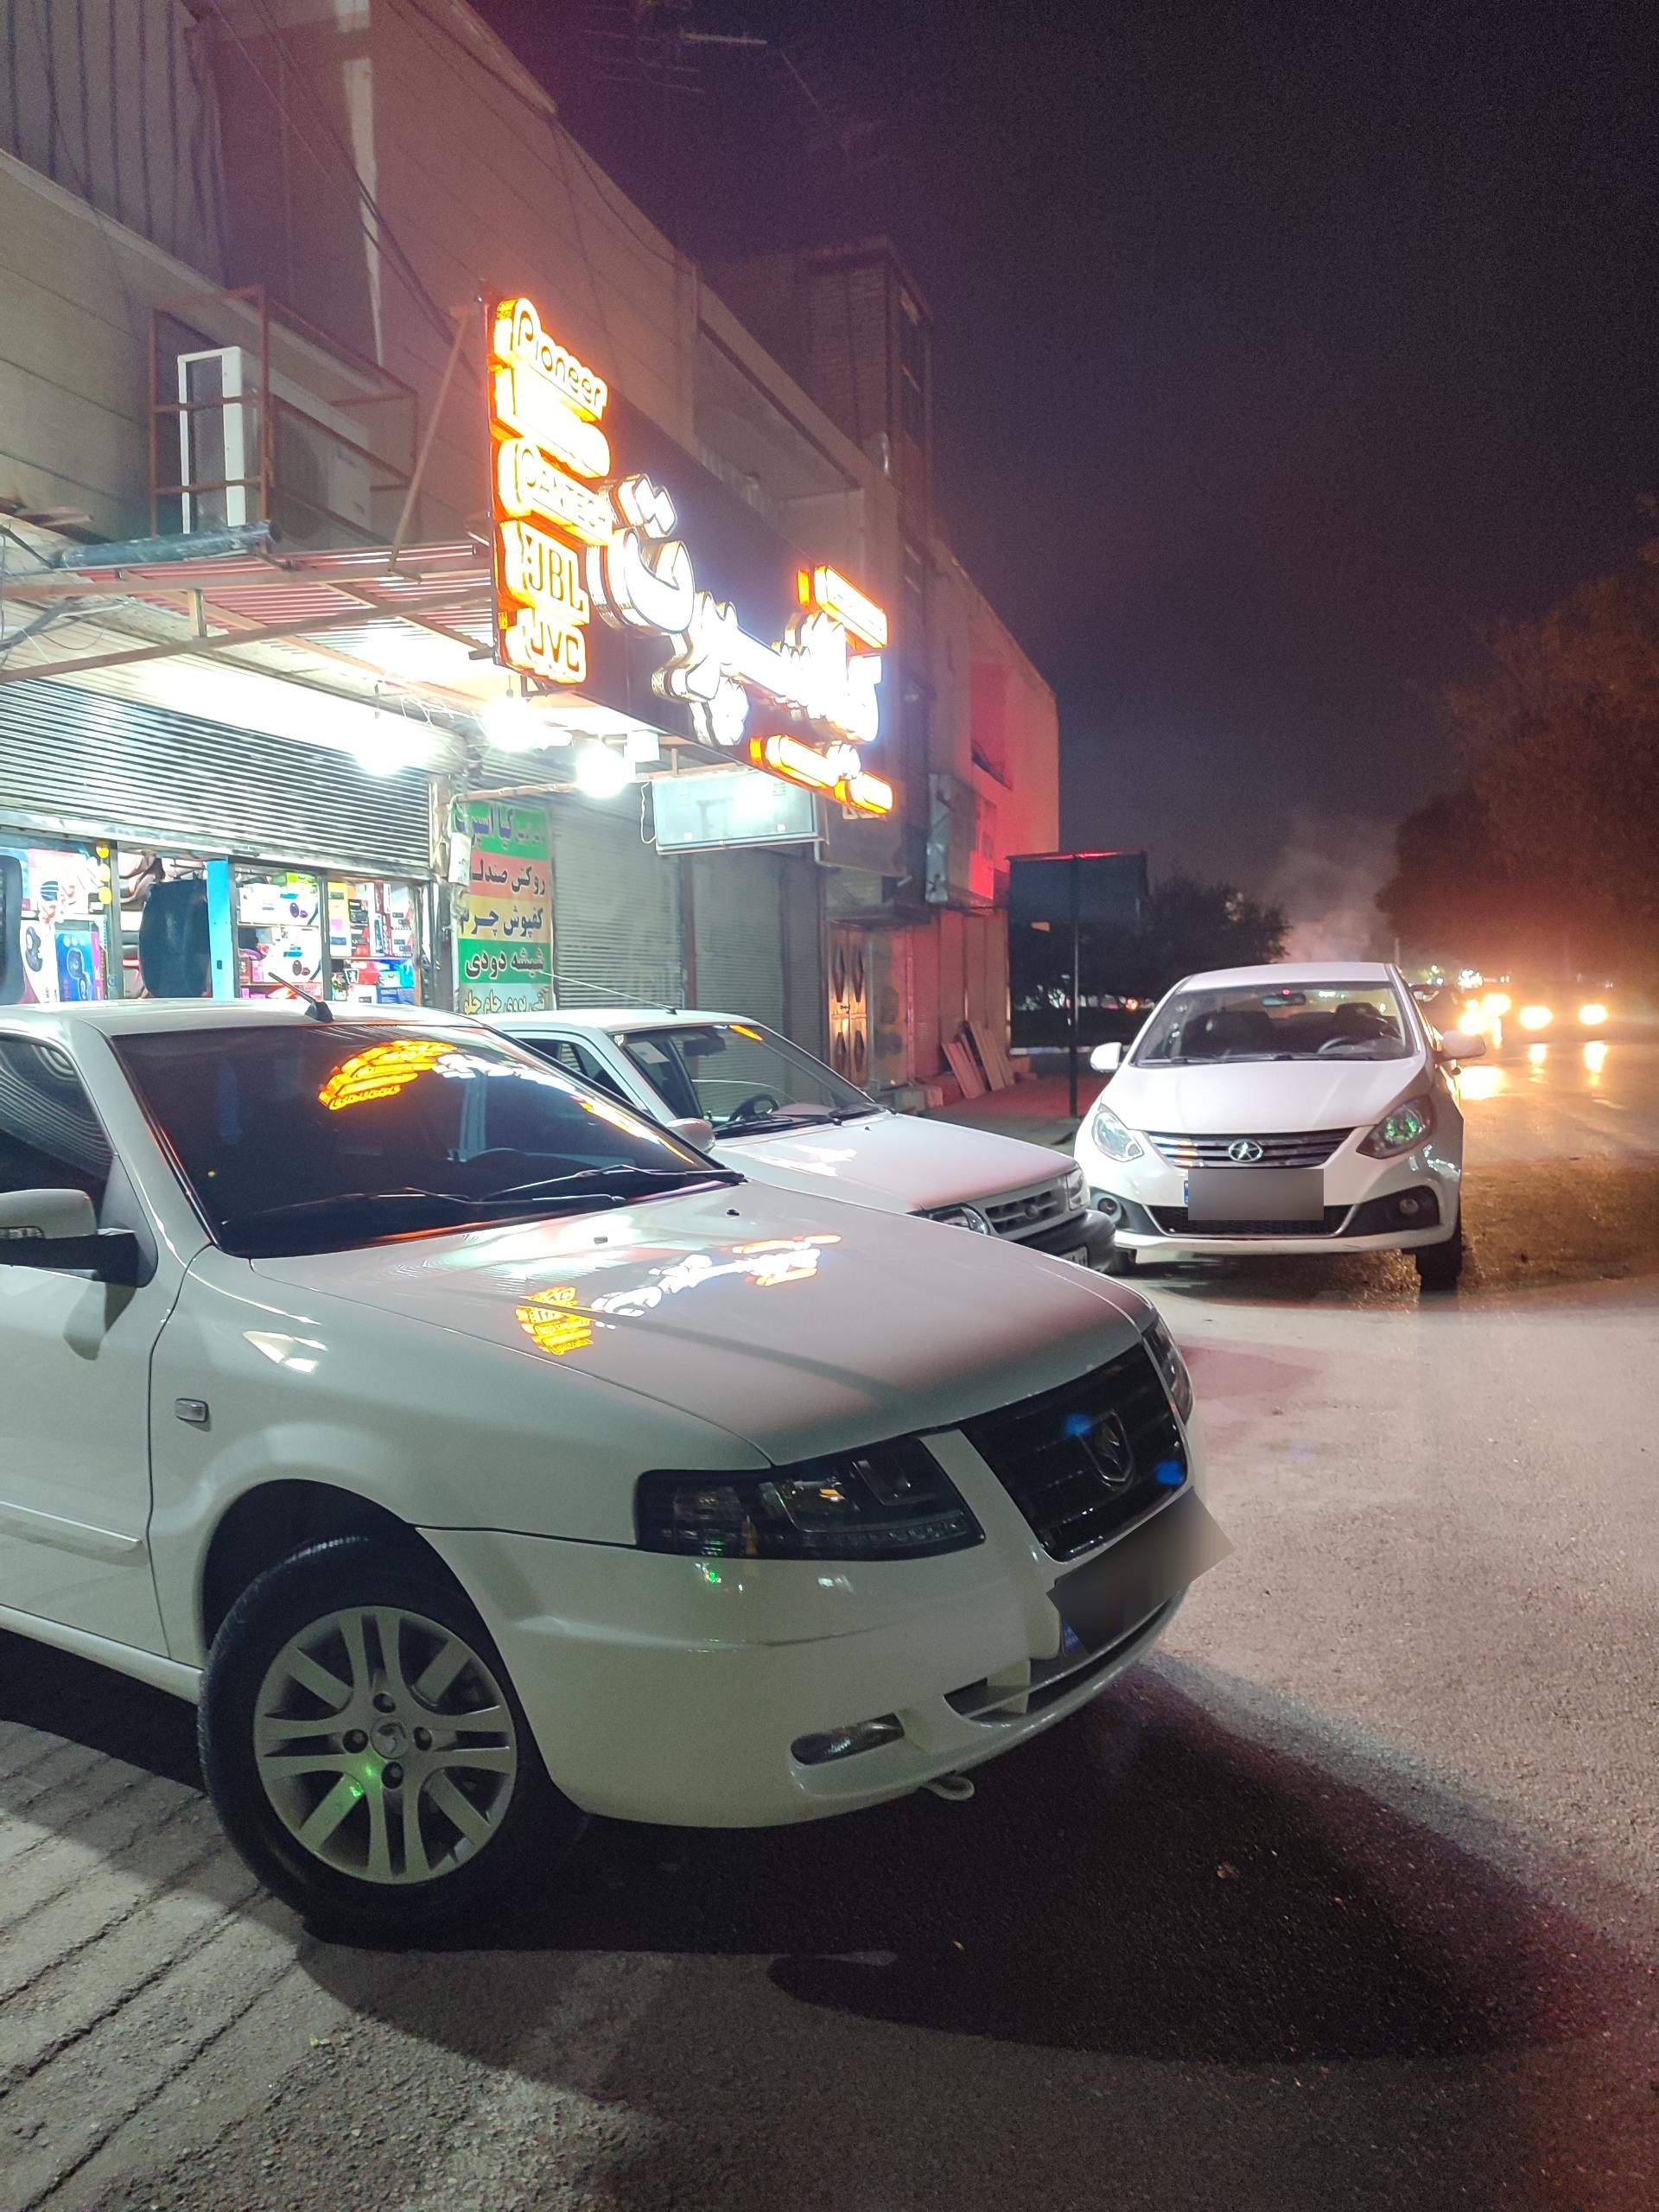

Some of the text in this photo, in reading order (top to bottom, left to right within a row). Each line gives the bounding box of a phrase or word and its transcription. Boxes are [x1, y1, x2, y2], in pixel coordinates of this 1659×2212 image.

[517, 309, 602, 408] Pioneer
[524, 533, 584, 612] JBL
[529, 620, 581, 674] JVC
[471, 858, 508, 884] صندل
[460, 906, 543, 939] کفپوش چرم
[465, 947, 543, 979] شیشه دودی
